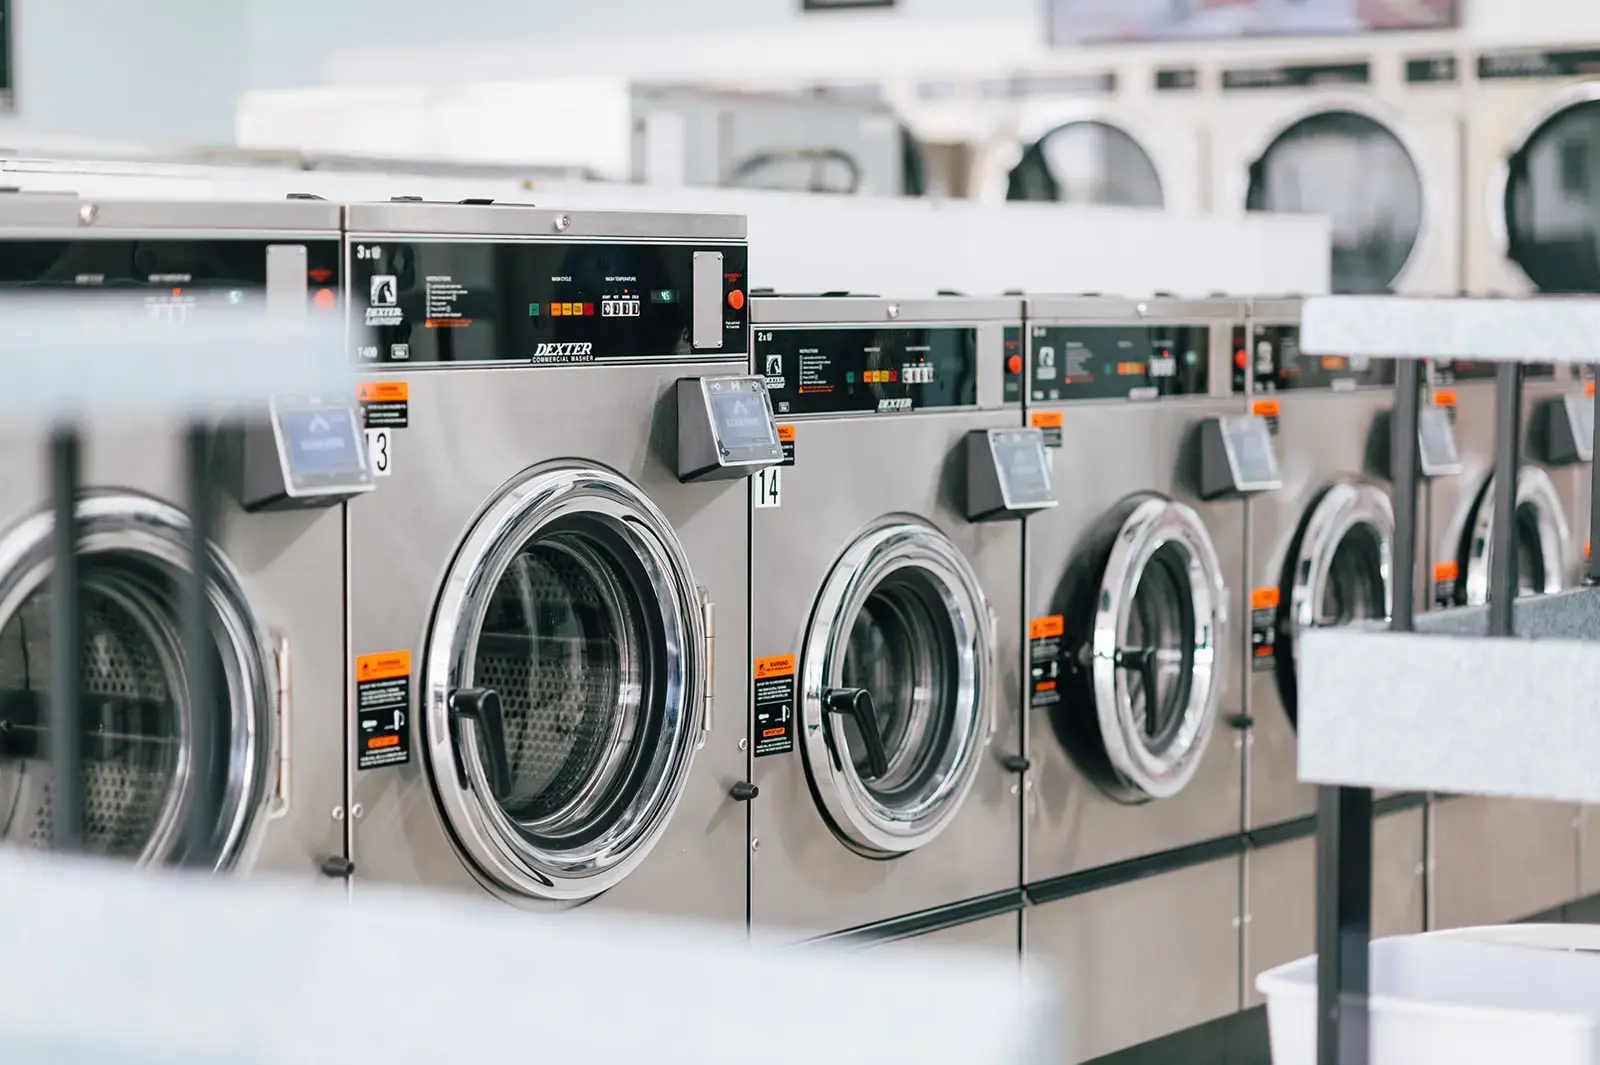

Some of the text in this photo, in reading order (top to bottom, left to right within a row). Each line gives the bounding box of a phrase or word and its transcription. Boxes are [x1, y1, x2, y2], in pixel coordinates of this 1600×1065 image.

[534, 342, 593, 356] DEXTER
[878, 398, 912, 408] DEXTER
[759, 469, 778, 504] 14
